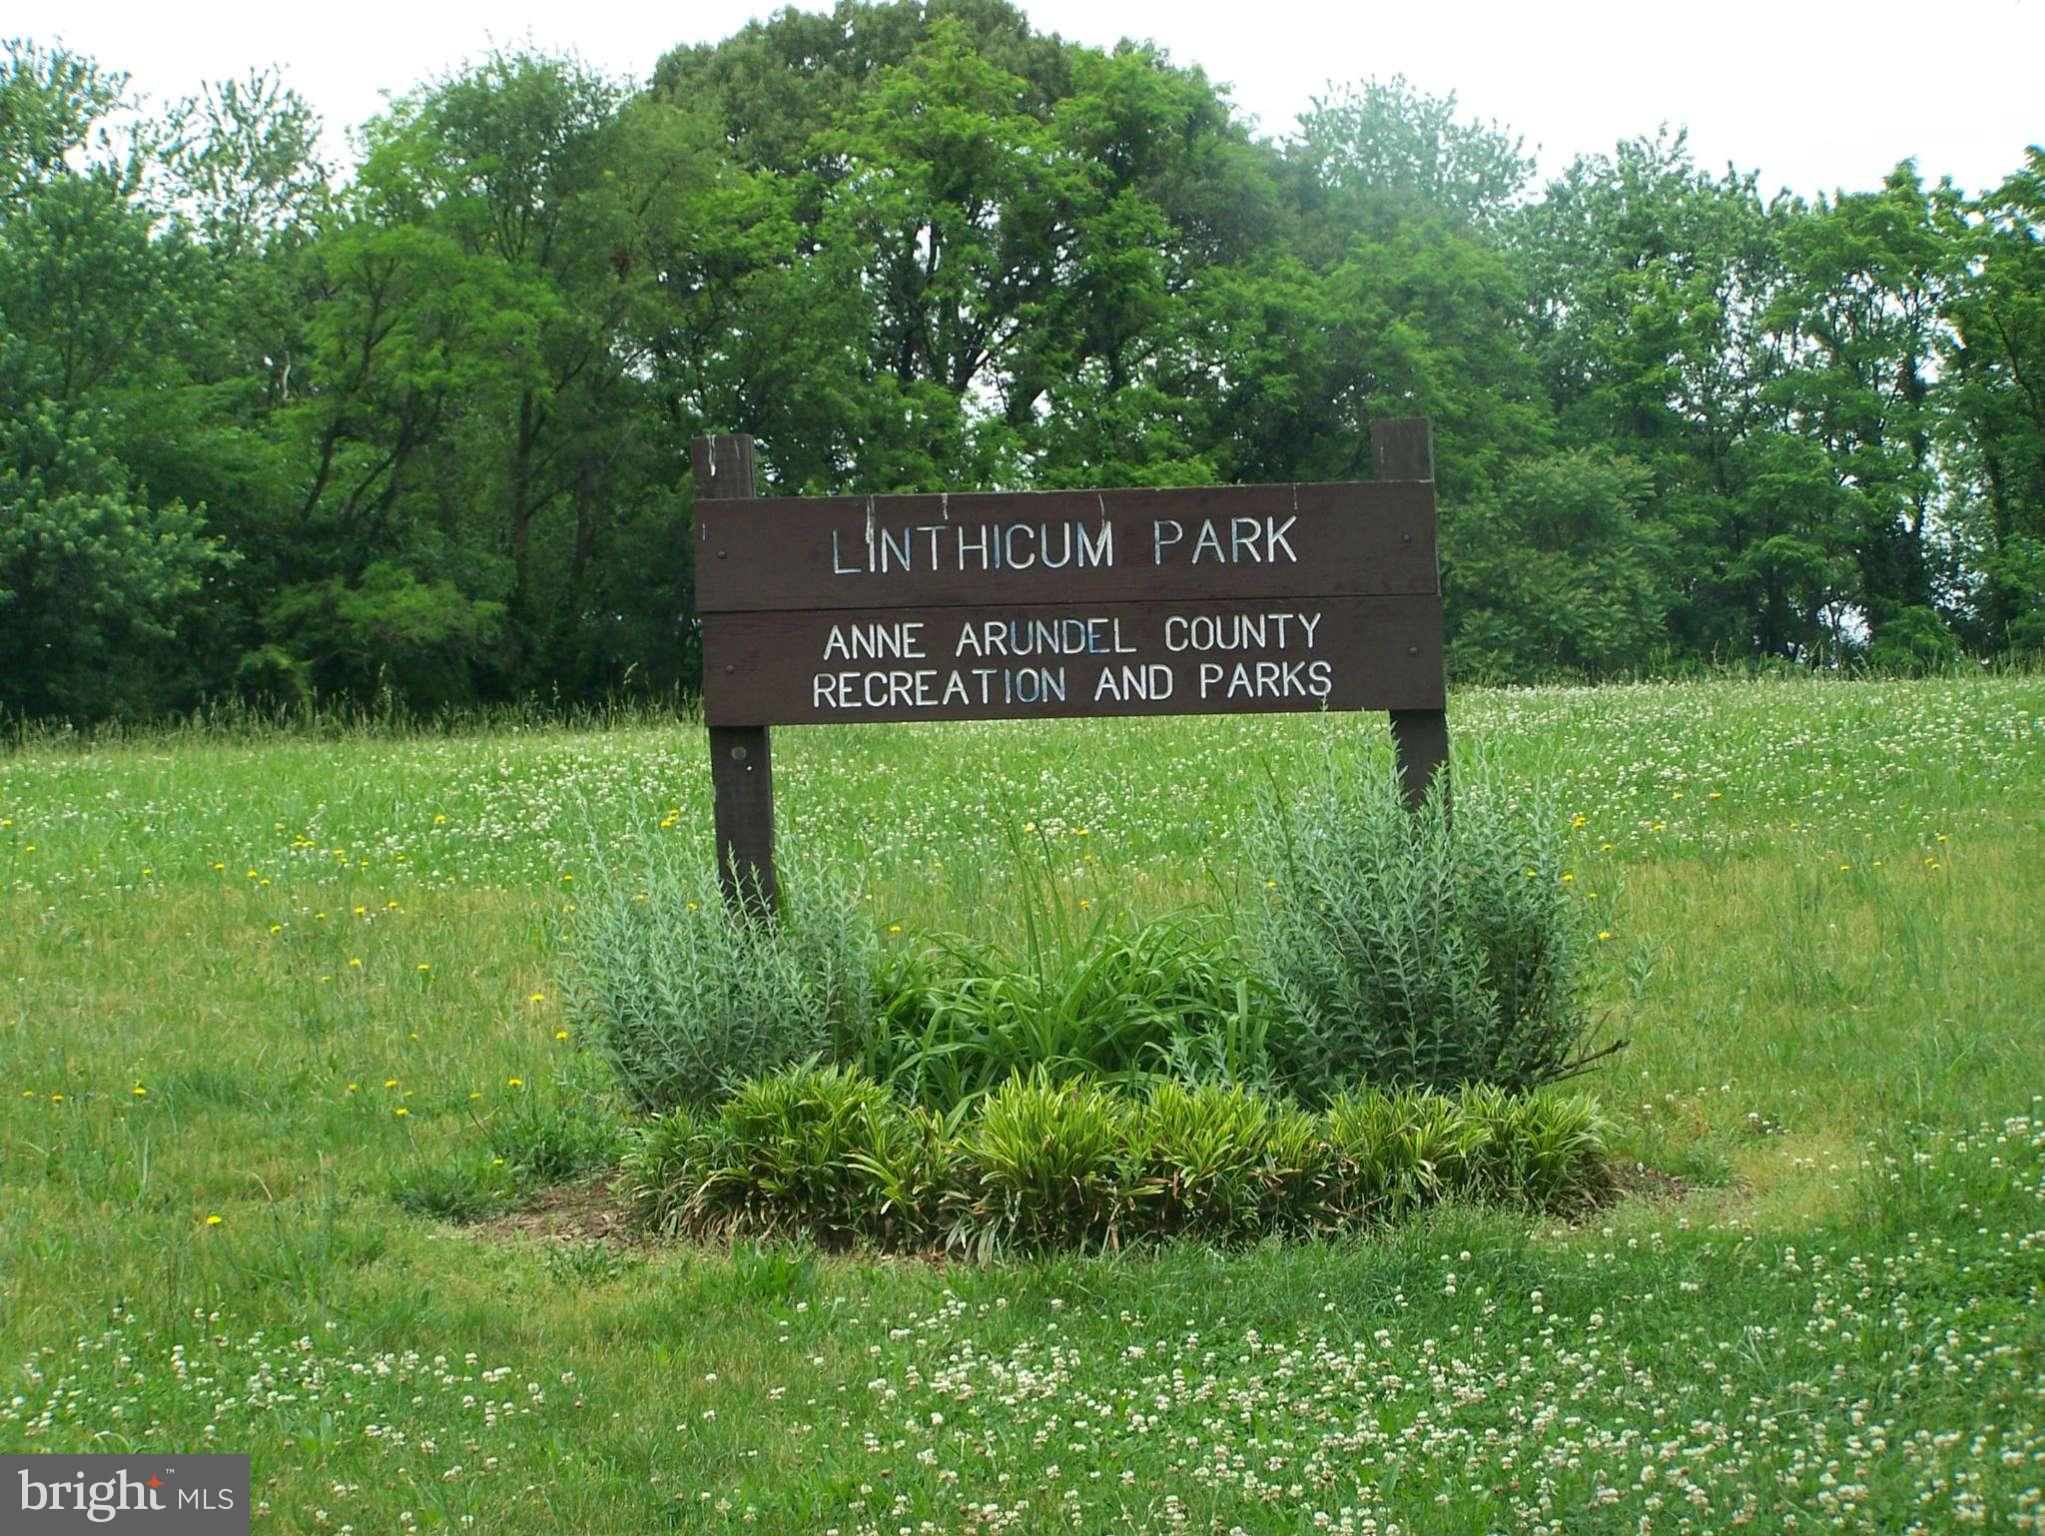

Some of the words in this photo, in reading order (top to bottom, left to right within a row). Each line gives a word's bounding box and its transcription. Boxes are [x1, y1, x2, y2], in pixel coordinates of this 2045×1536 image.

[832, 519, 1114, 575] LINTHICUM
[1153, 515, 1299, 566] PARK
[822, 621, 926, 661] ANNE
[955, 617, 1137, 656] ARUNDEL
[1164, 612, 1323, 652] COUNTY
[812, 665, 1067, 709] RECREATION
[1093, 663, 1174, 704] AND
[1200, 660, 1334, 700] PARKS
